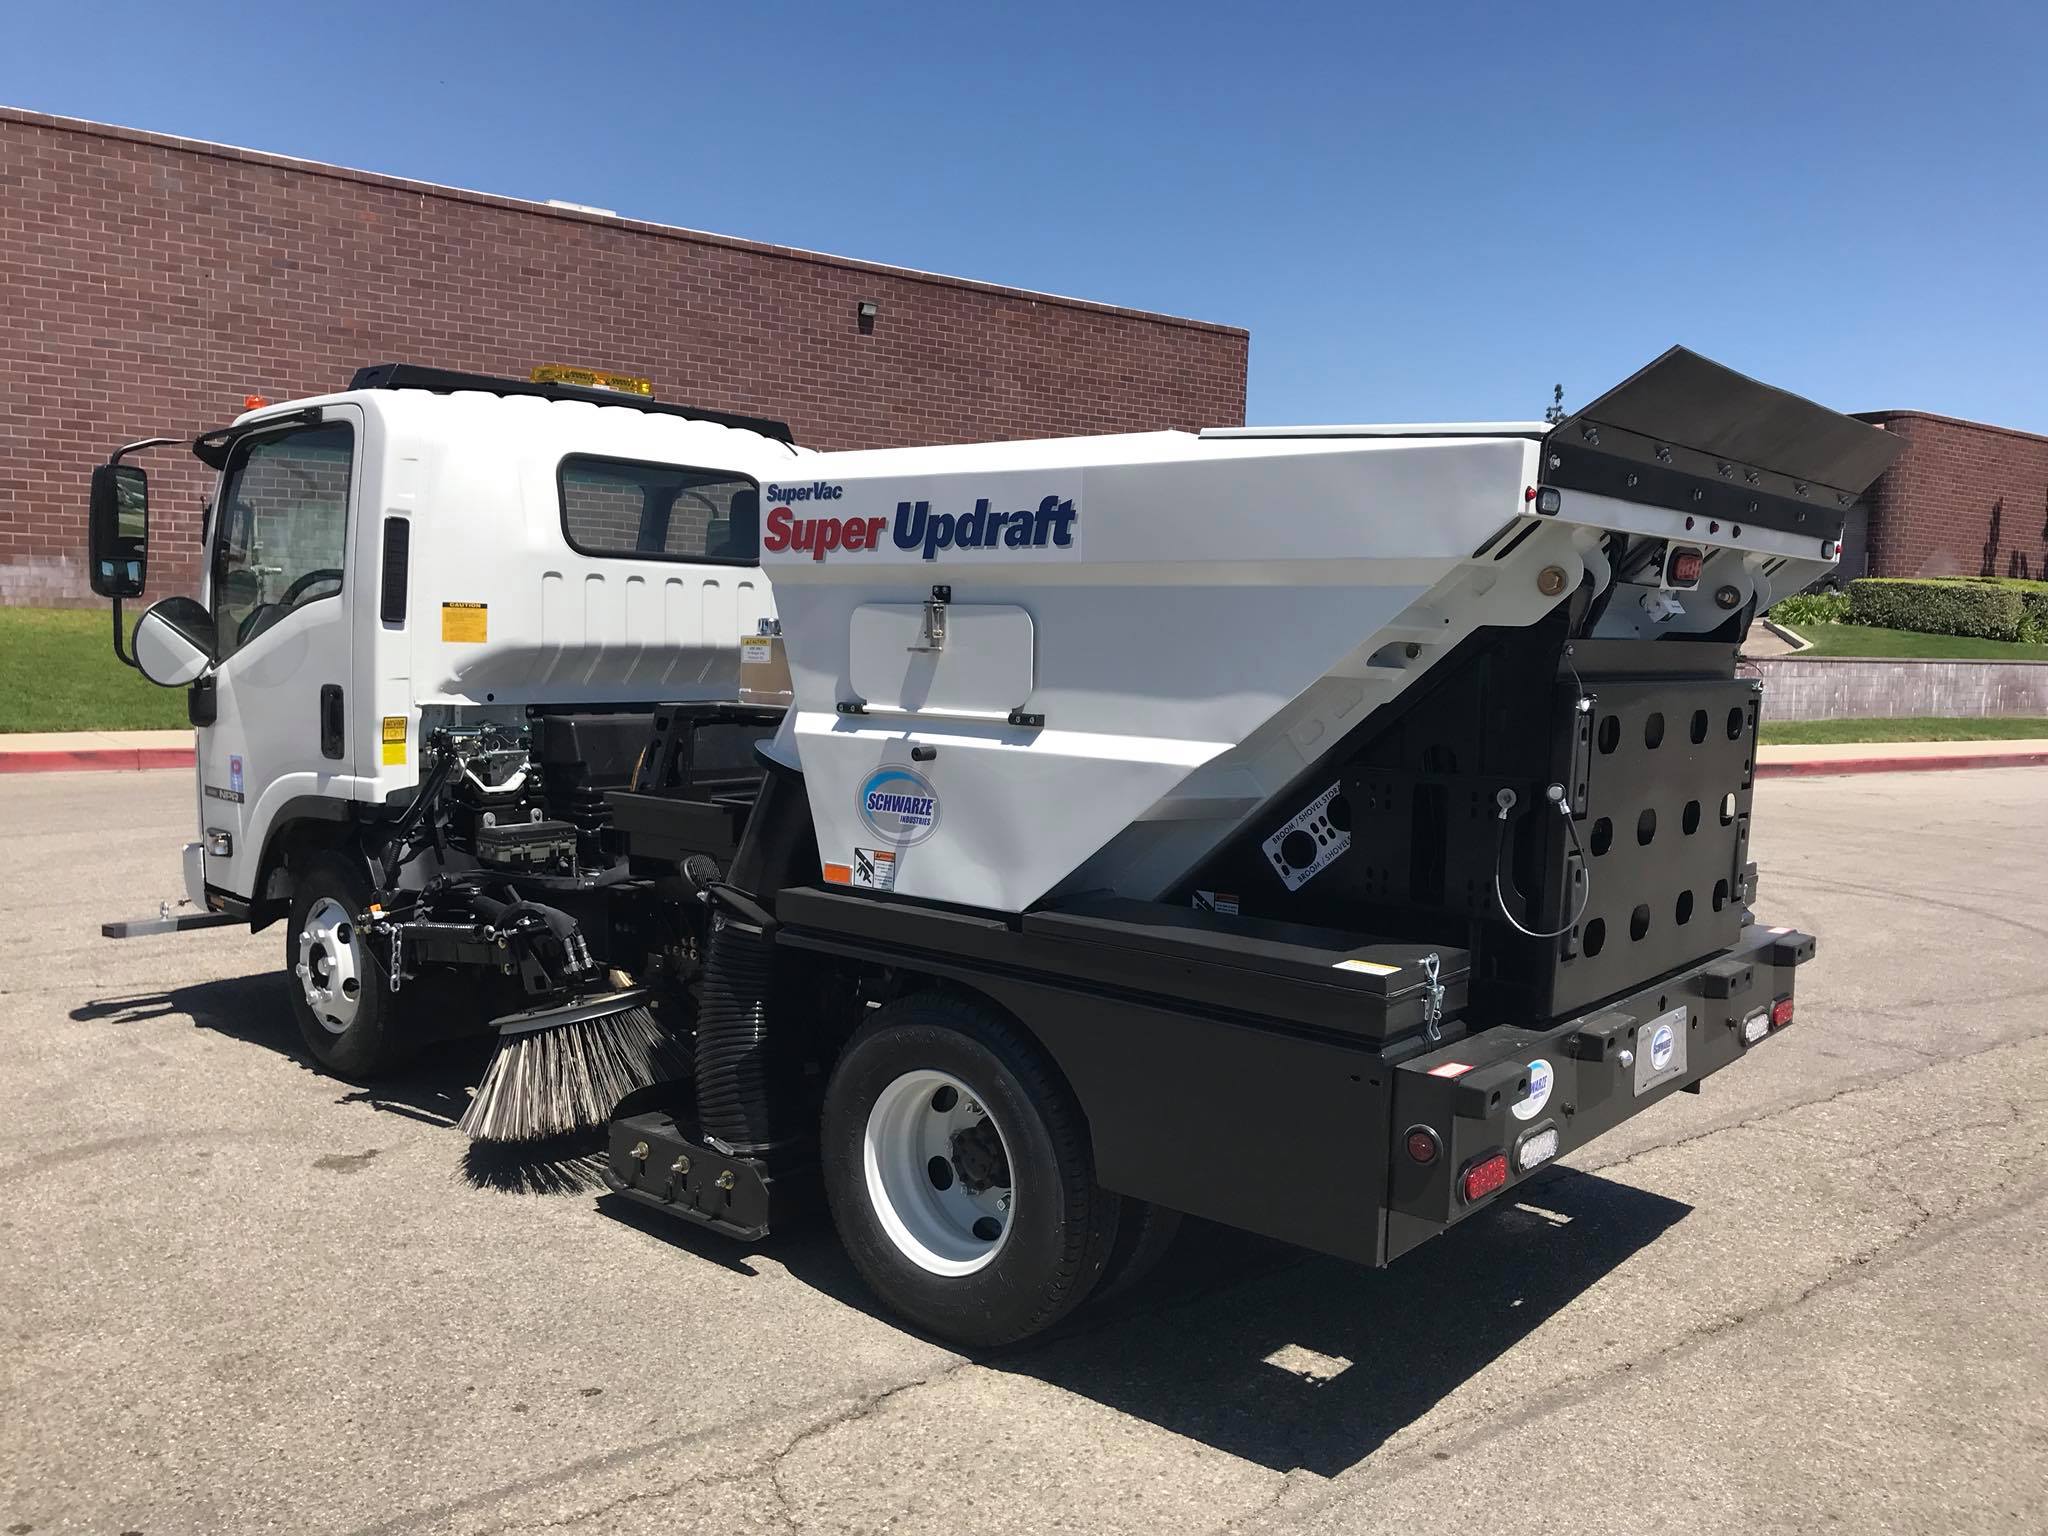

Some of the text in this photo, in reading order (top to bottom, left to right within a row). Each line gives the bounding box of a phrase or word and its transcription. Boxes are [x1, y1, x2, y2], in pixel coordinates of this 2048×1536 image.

[767, 481, 843, 505] SuperVac
[764, 495, 1077, 561] Super Updraft
[867, 792, 934, 815] SCHWARZE
[899, 815, 931, 826] INDUSTRIES
[1272, 823, 1297, 845] BROOM
[1299, 800, 1323, 822] SHOVEL
[1297, 861, 1322, 883] BROOM
[1324, 838, 1349, 862] SHOVEL
